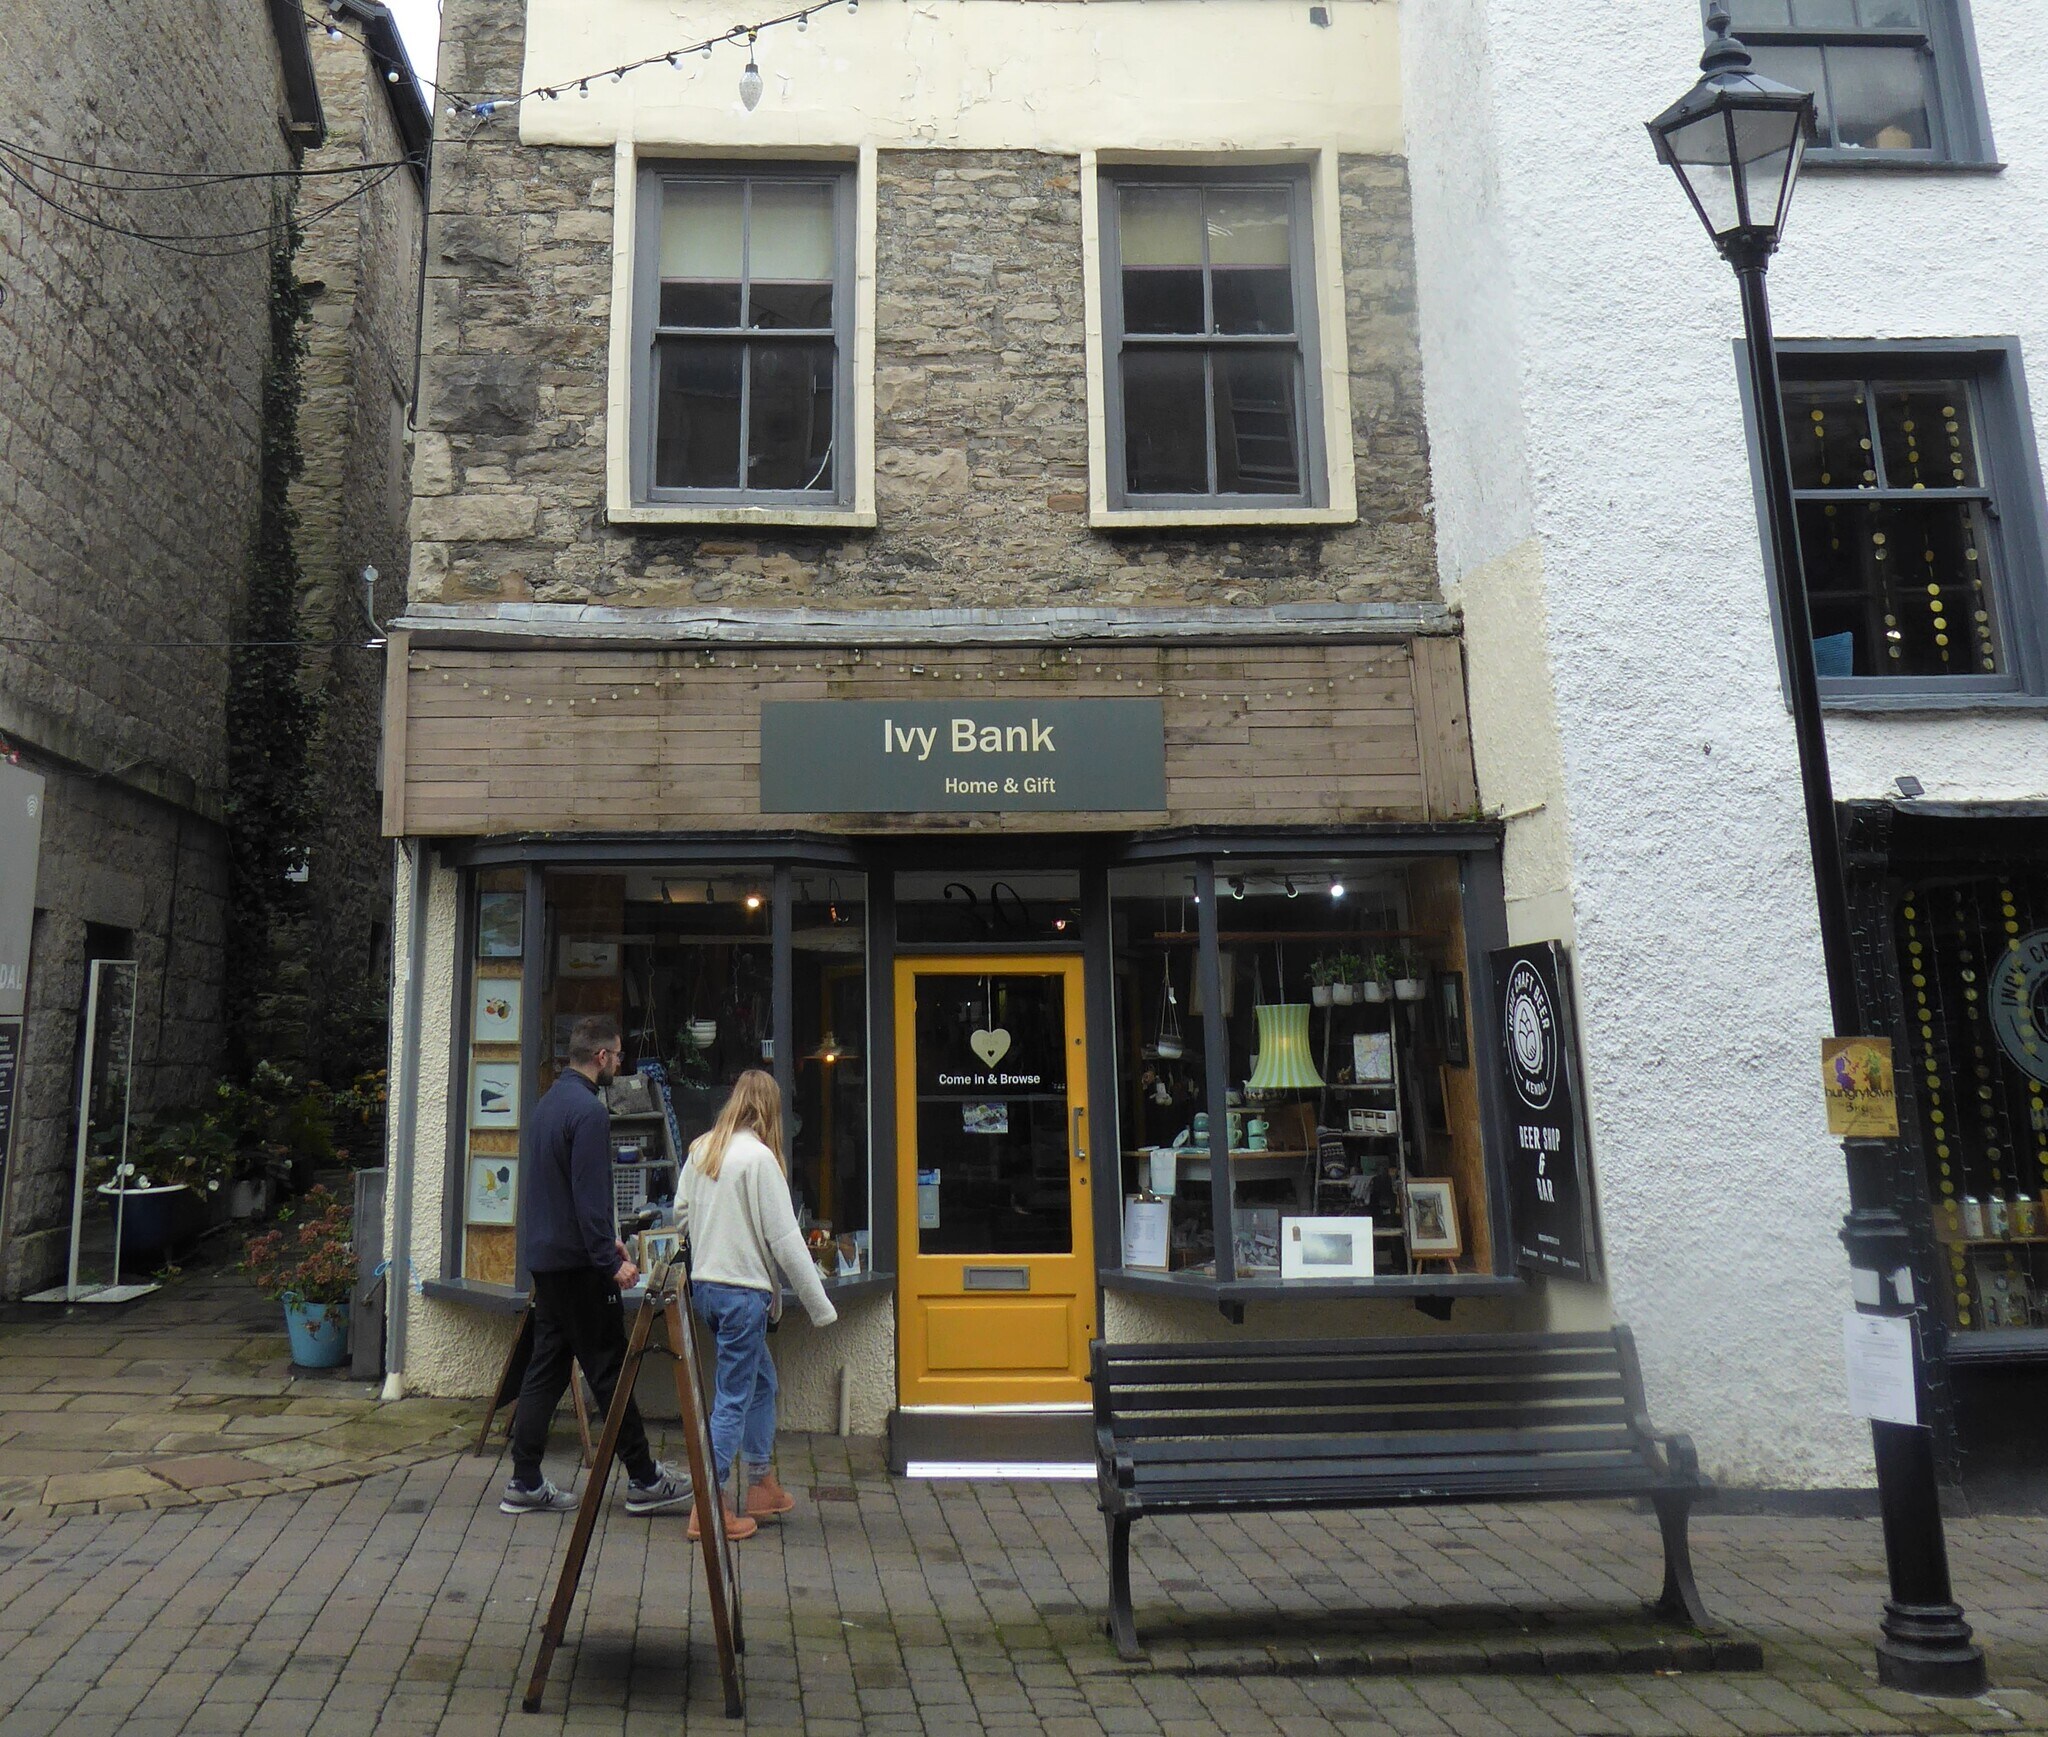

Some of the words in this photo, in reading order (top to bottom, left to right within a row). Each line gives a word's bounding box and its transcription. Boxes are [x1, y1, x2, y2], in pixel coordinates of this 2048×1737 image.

[884, 718, 937, 761] Ivy
[951, 718, 1056, 753] Bank
[945, 777, 998, 794] Home
[1003, 777, 1019, 794] &
[1023, 777, 1056, 794] Gift
[1514, 971, 1535, 994] CRAFT
[1533, 985, 1550, 1030] BEER
[939, 1073, 972, 1085] Come
[987, 1073, 998, 1085] &
[1000, 1073, 1041, 1085] Browse
[1525, 1078, 1547, 1096] KENDAL
[1518, 1125, 1541, 1150] BEER
[1542, 1127, 1561, 1151] SHOP
[1536, 1178, 1555, 1203] BAR
